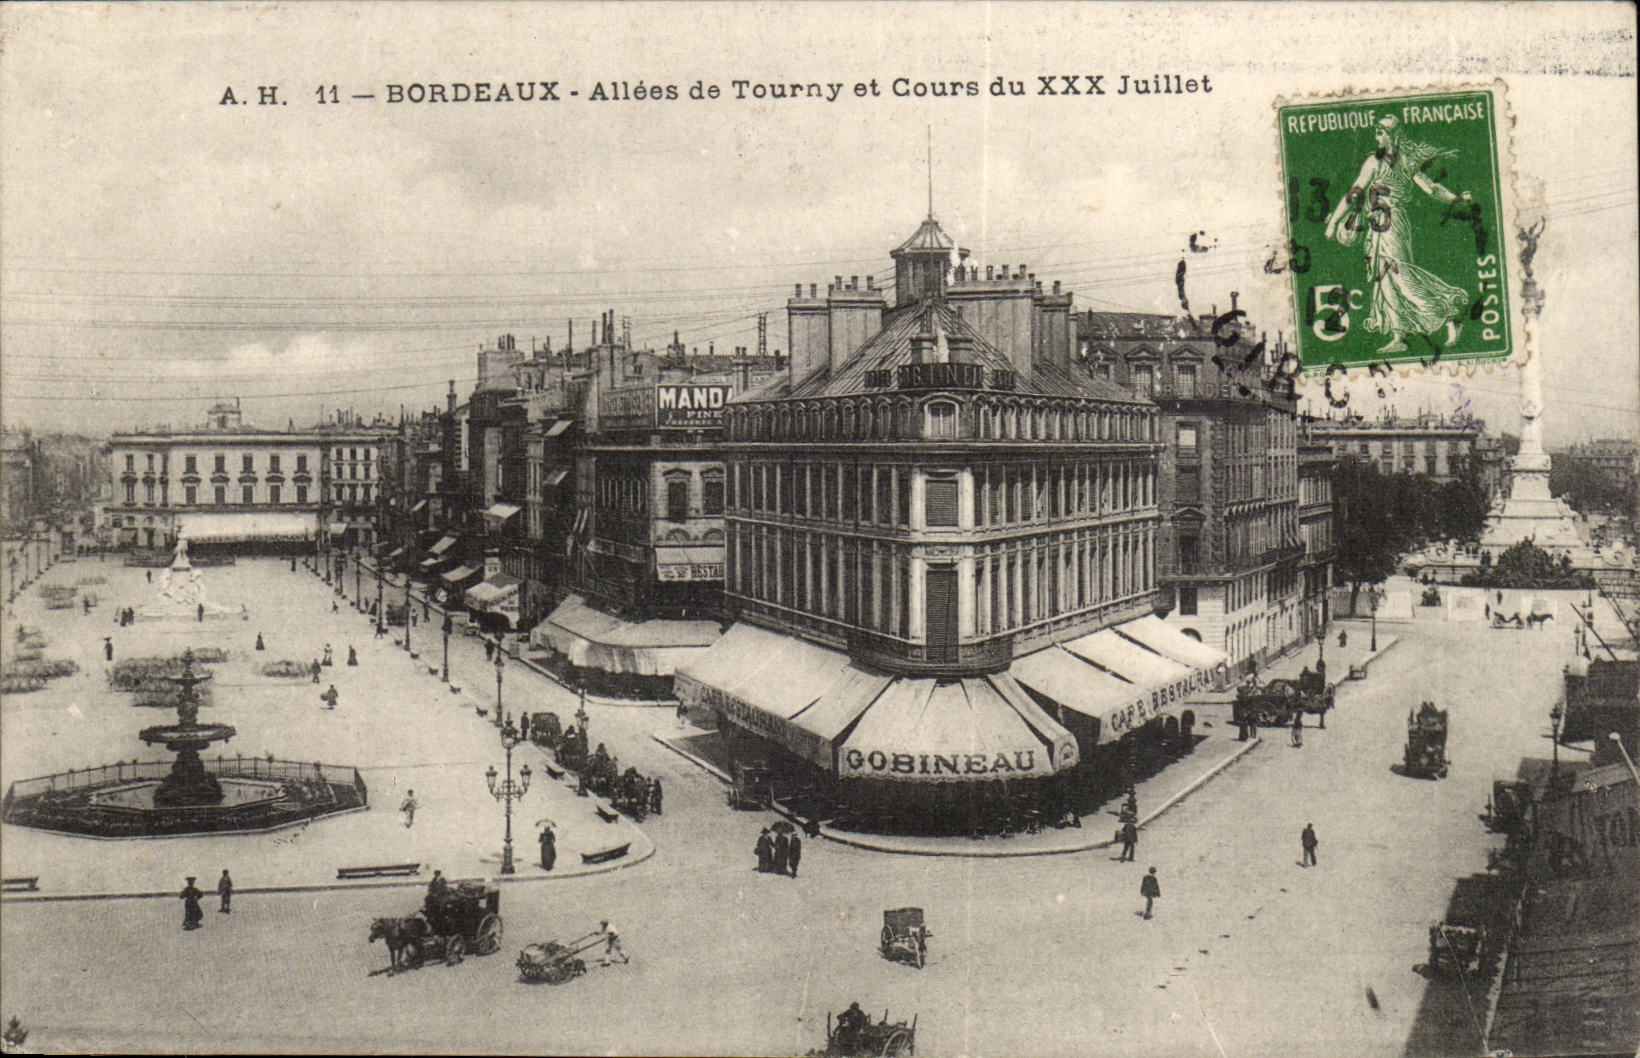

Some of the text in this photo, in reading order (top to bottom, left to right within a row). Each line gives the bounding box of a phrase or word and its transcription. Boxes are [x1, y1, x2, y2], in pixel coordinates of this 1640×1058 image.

[1402, 101, 1486, 125] FRANÇAISE
[1477, 254, 1501, 341] POSTES
[846, 749, 1034, 775] GOBINEAU
